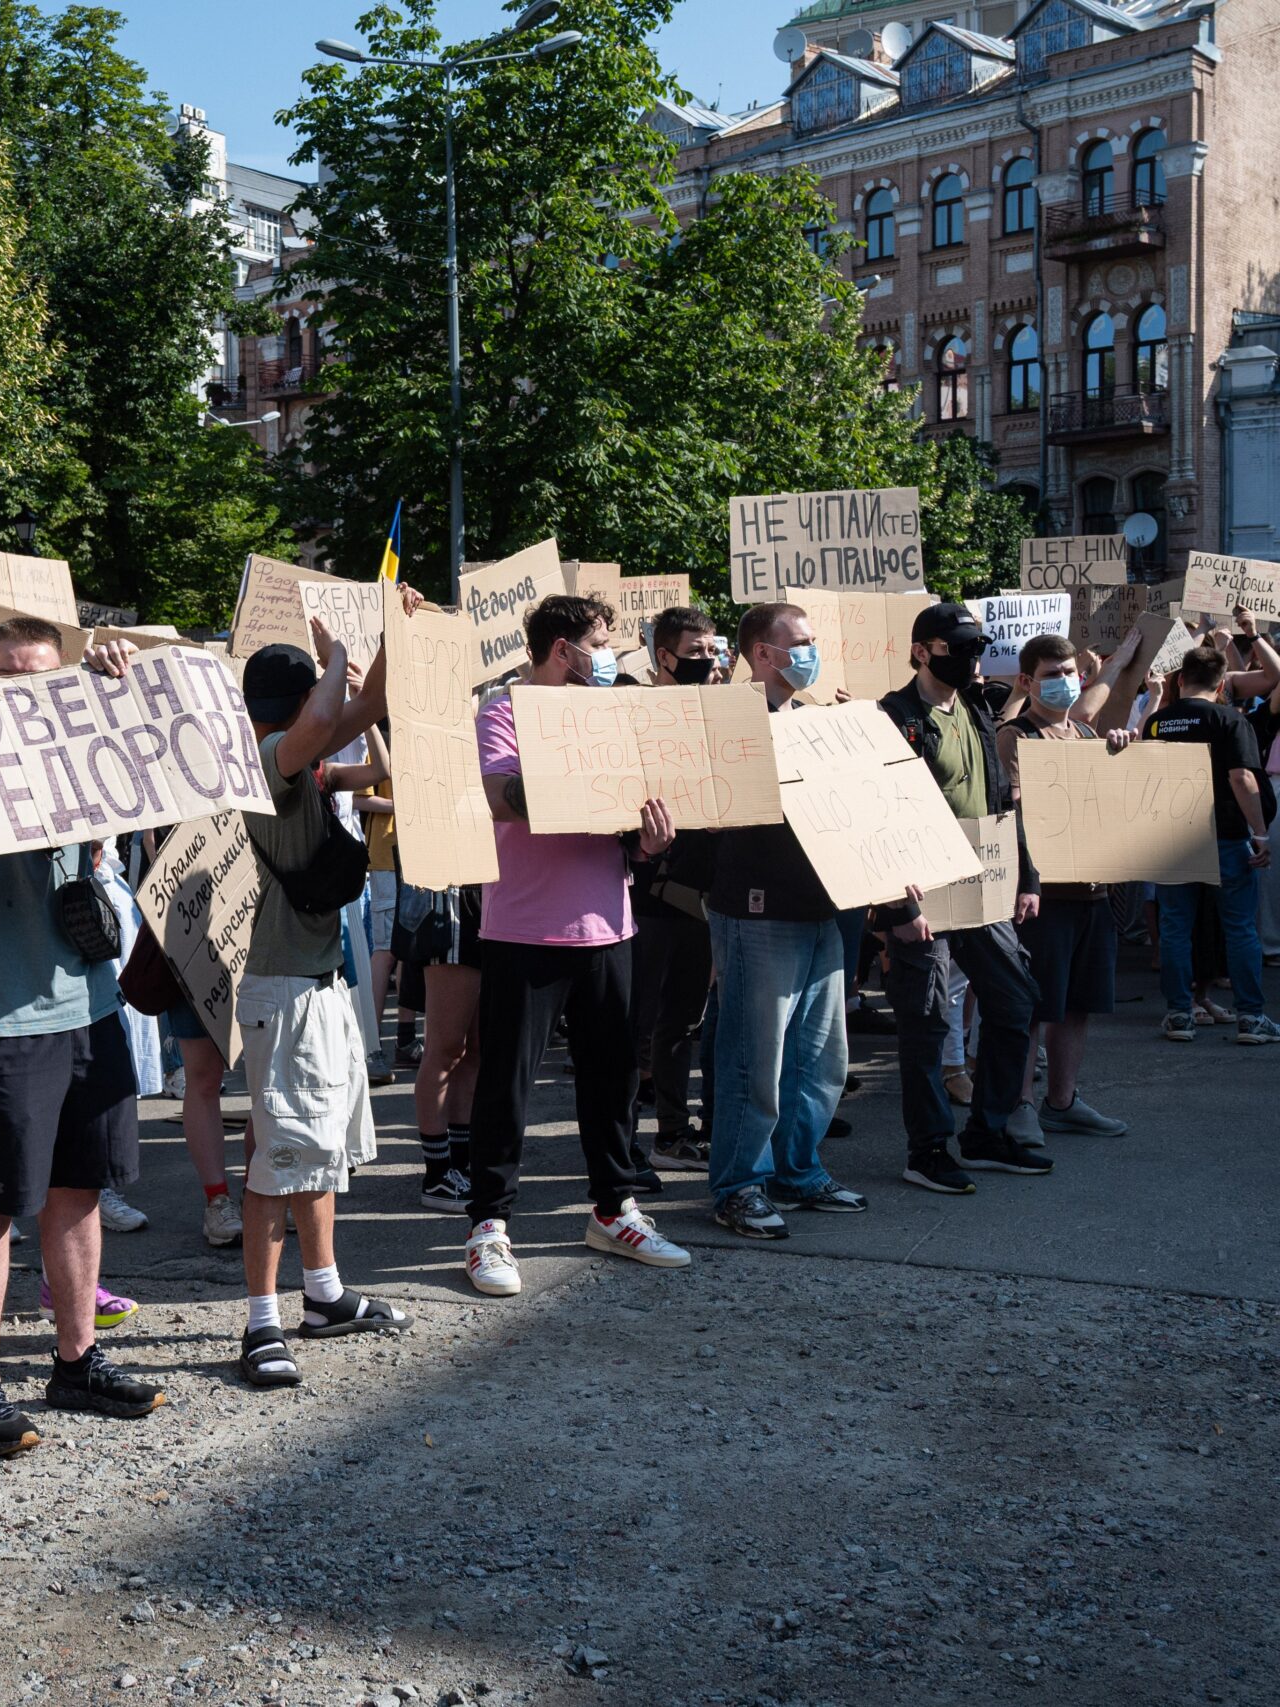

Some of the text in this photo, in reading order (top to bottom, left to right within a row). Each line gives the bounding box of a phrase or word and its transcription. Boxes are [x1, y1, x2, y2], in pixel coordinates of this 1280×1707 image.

[740, 499, 788, 546] НЕ
[733, 551, 768, 595] ТЕ
[1028, 538, 1127, 565] LET HIM
[1028, 562, 1094, 590] COOK
[986, 599, 1023, 623] ВАШІ
[537, 699, 714, 741] LACTOSE
[1158, 725, 1189, 734] НОВИНИ
[1159, 718, 1201, 727] СУСПІЛЬНЕ
[556, 732, 768, 777] INTOLERANCE
[591, 773, 733, 821] SQUAD
[1044, 761, 1102, 839] ЗА
[207, 886, 261, 964] Сирськи
